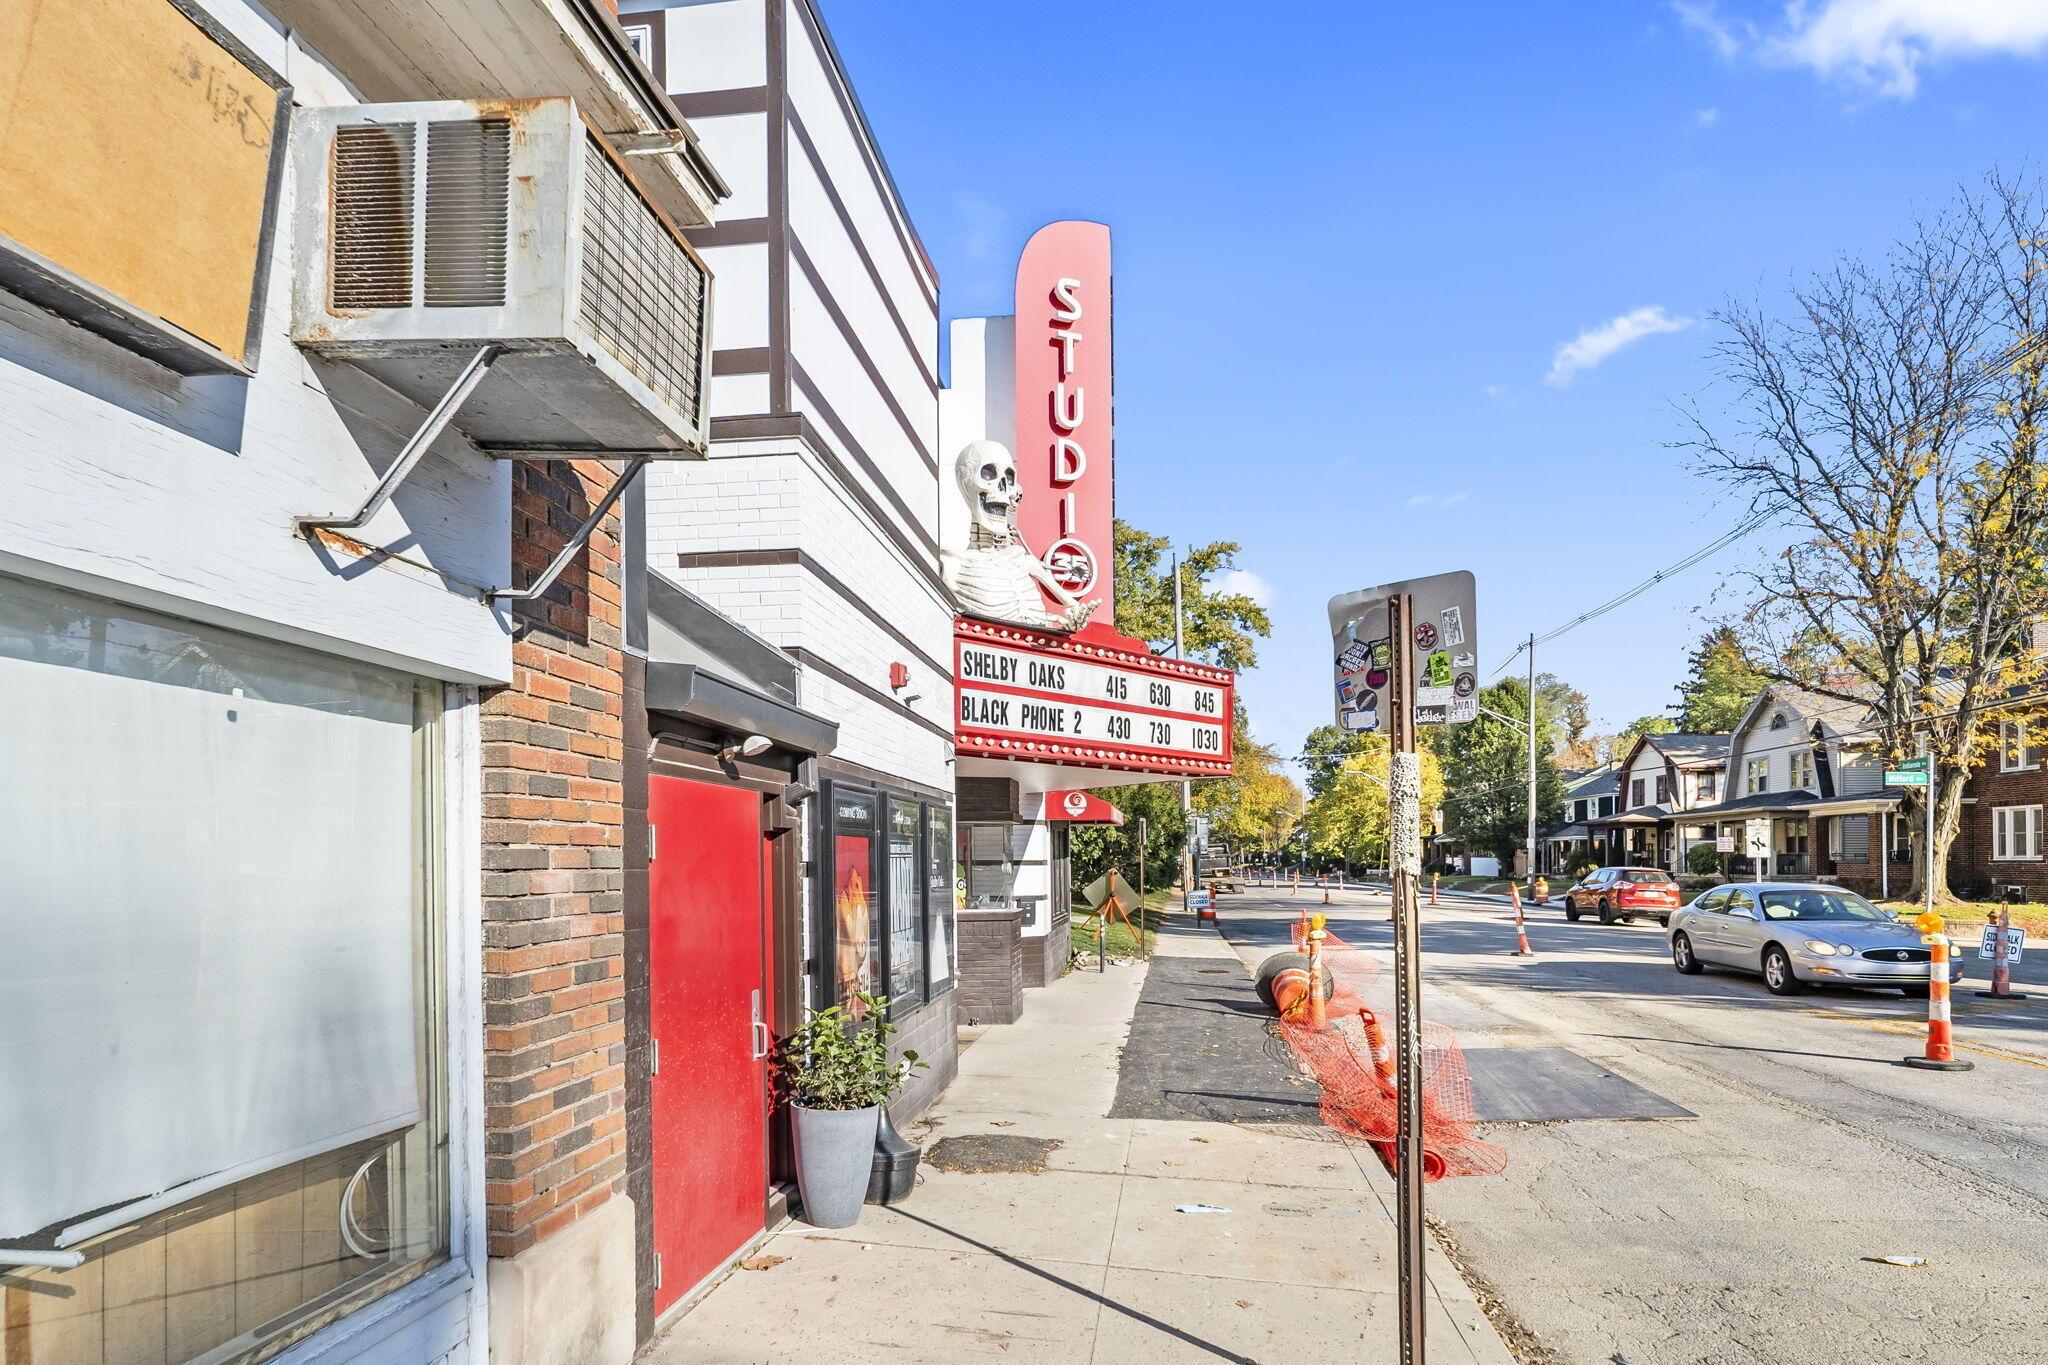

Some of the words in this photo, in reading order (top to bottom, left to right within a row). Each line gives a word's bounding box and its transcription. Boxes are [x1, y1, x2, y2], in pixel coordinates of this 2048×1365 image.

[1045, 278, 1099, 599] STUDIO
[1053, 552, 1088, 583] 35
[964, 650, 1018, 682] SHELBY
[1029, 661, 1065, 690] OAKS
[1106, 675, 1127, 700] 415
[1150, 682, 1171, 707] 630
[1195, 690, 1214, 713] 845
[961, 695, 1009, 726] BLACK
[1021, 704, 1064, 732] PHONE
[1073, 710, 1082, 734] 2
[1107, 715, 1131, 740] 430
[1150, 722, 1171, 745] 730
[1192, 727, 1218, 751] 1030
[1888, 774, 1914, 782] Milford
[1985, 943, 2017, 955] CLED
[1986, 932, 2020, 945] SIDALK
